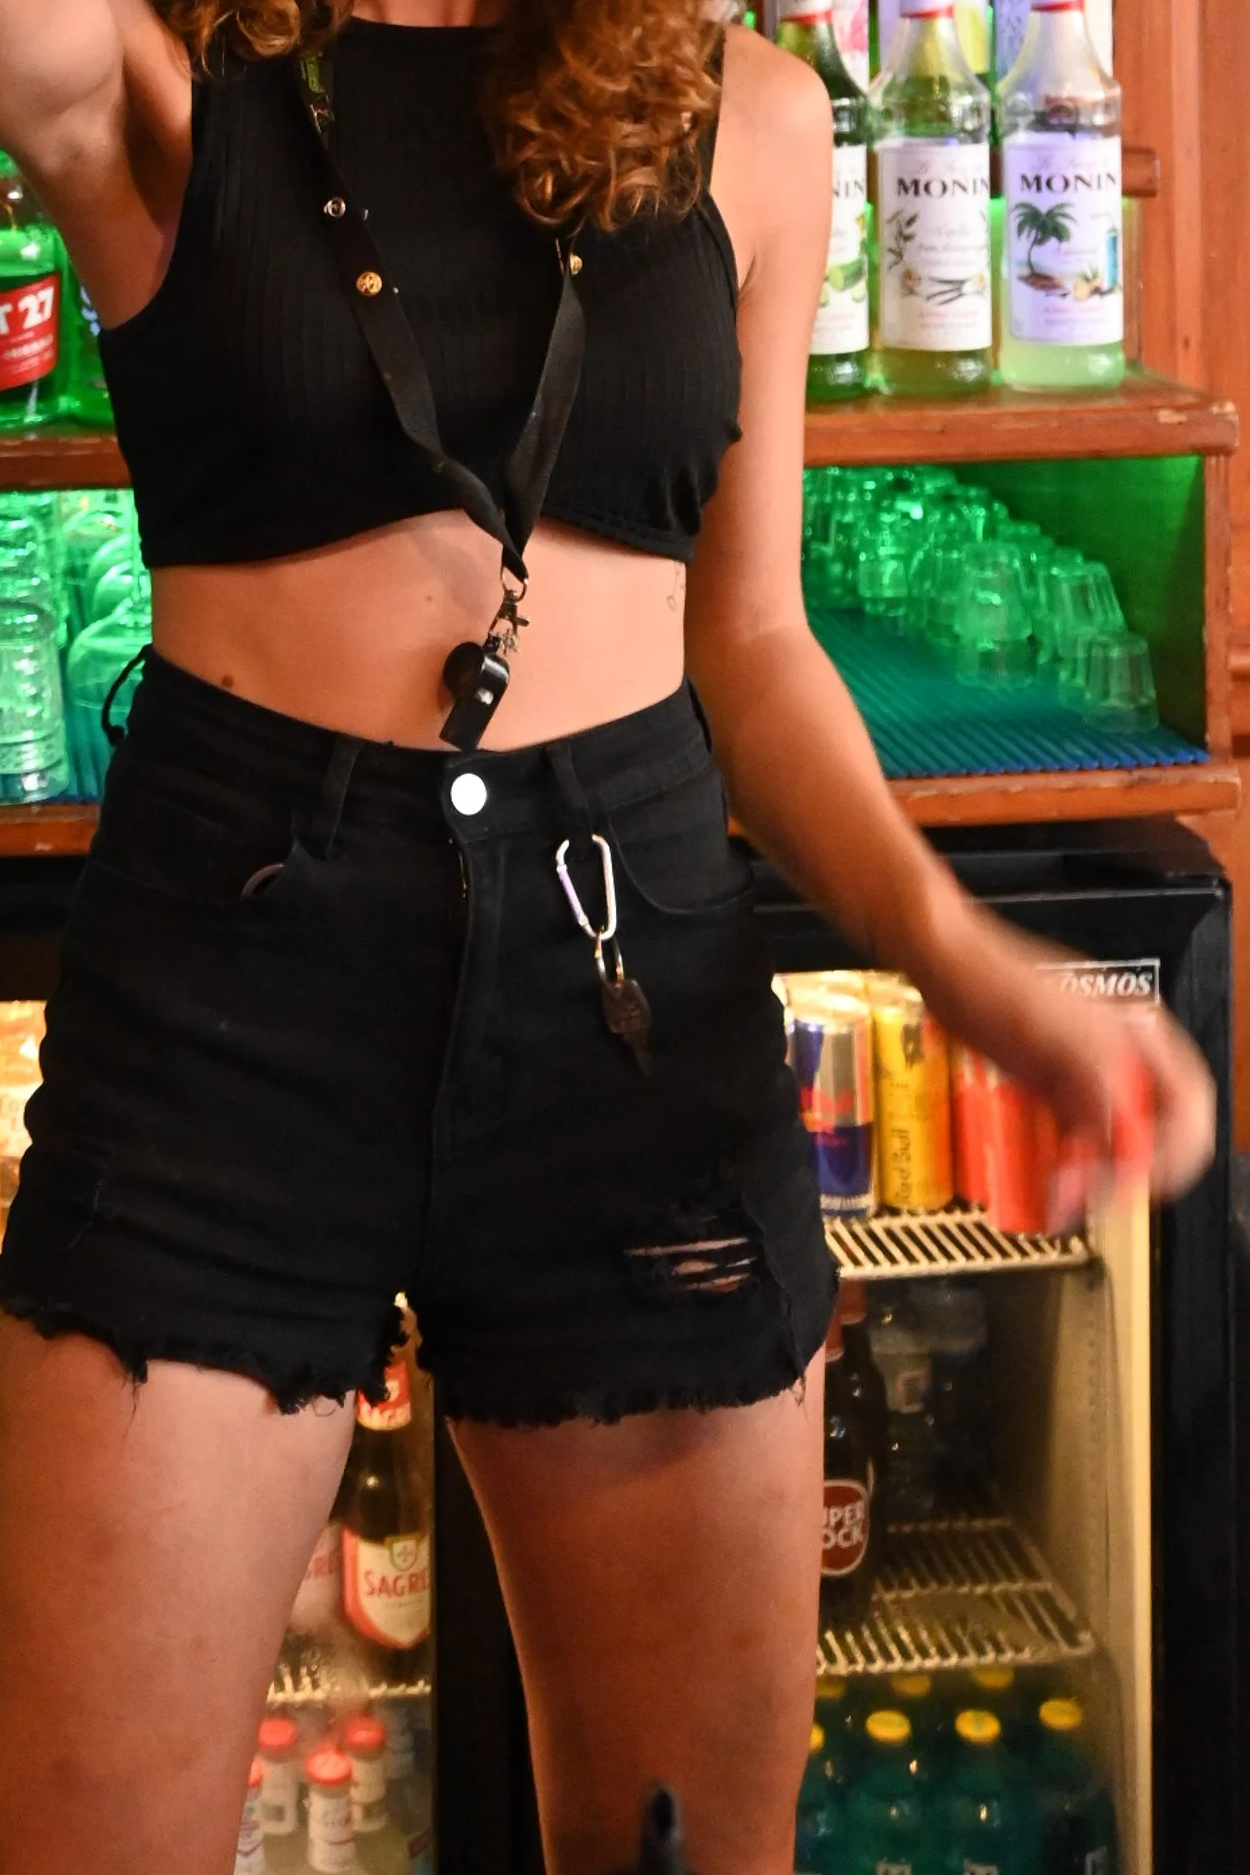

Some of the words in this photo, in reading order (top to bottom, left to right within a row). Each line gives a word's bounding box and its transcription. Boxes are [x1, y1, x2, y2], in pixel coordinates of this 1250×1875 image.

[897, 177, 989, 198] MONIN
[1020, 173, 1117, 194] MONIN
[18, 285, 55, 329] 27
[1060, 970, 1152, 997] OSMOS
[822, 1527, 863, 1549] OCK
